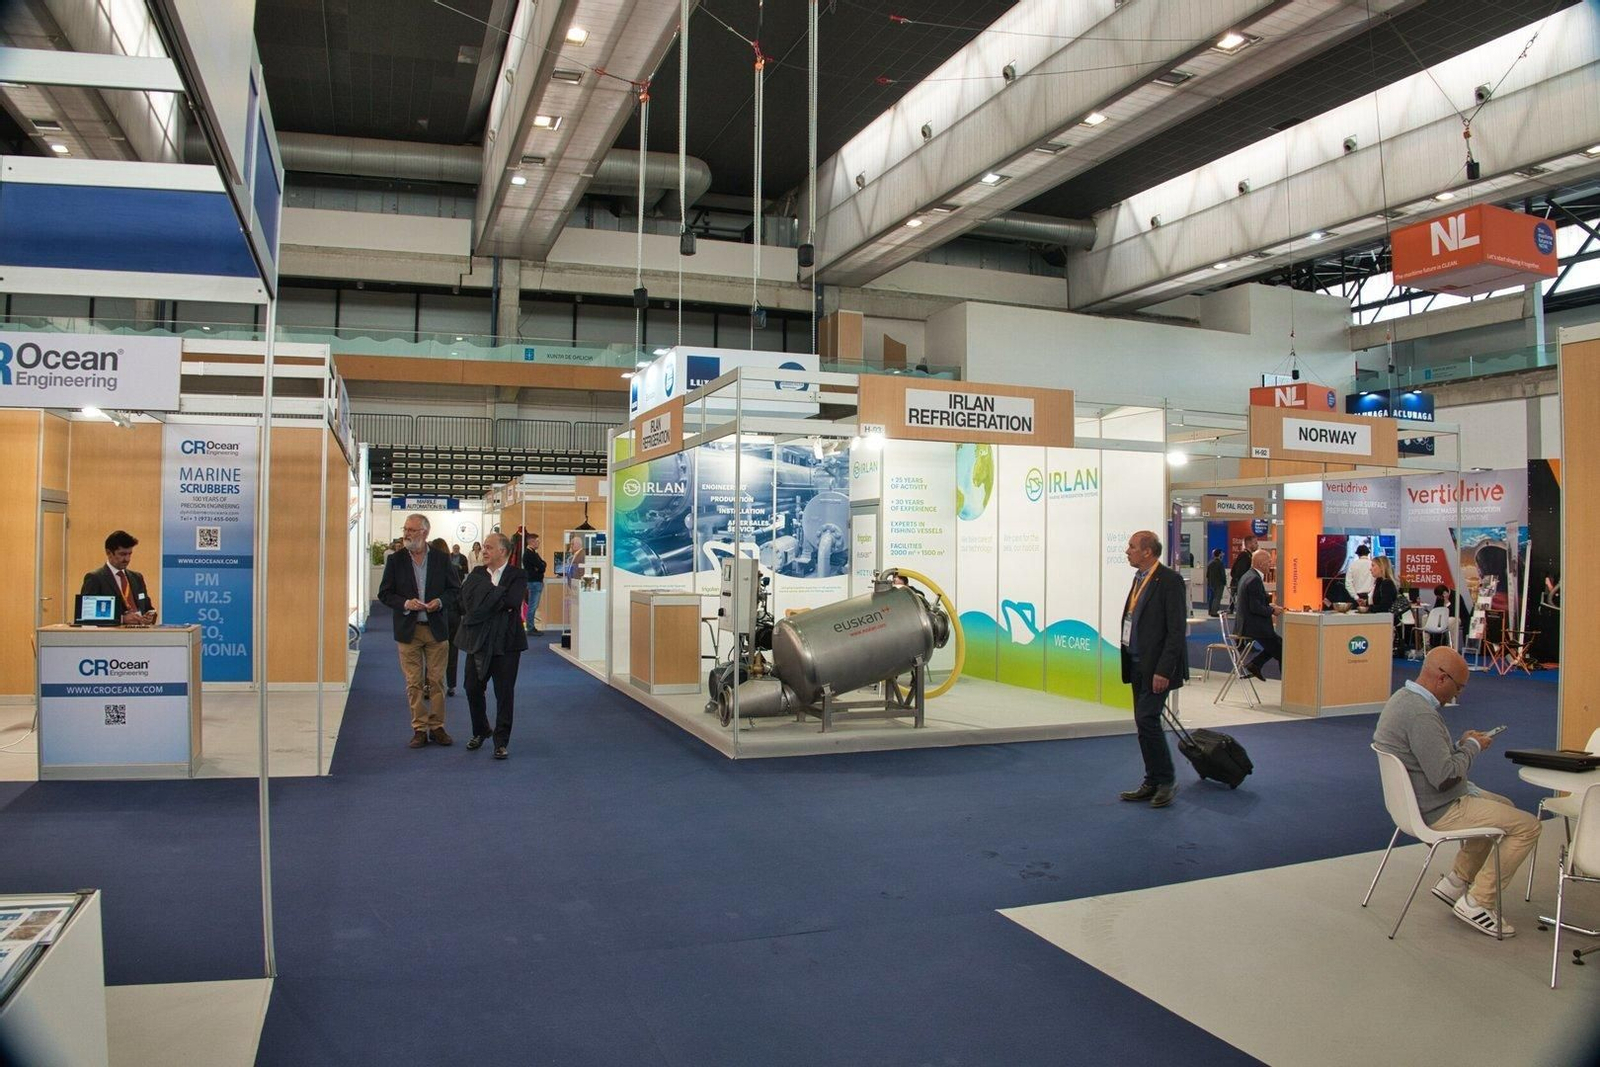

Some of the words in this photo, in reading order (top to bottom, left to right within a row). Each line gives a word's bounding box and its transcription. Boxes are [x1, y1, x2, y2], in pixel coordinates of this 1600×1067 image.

[1430, 213, 1480, 256] NL
[16, 371, 118, 391] Engineering
[949, 394, 994, 412] IRLAN
[1275, 387, 1304, 407] NL
[909, 408, 1032, 432] REFRIGERATION
[1299, 426, 1357, 445] NORWAY
[181, 440, 205, 454] CR
[180, 467, 241, 482] MARINE
[1049, 468, 1098, 493] IRLAN
[180, 484, 240, 495] SCRUBBERS
[643, 482, 685, 494] IRLAN
[1326, 482, 1368, 494] vertidrive
[1407, 479, 1504, 505] vertidrive
[1406, 554, 1438, 564] FASTER.
[1406, 564, 1434, 573] SAFER.
[195, 573, 219, 586] PM
[1406, 574, 1444, 583] CLEANER.
[184, 591, 232, 604] PM2.5
[1054, 634, 1067, 648] WE
[1068, 636, 1091, 651] CARE
[1351, 641, 1366, 651] TMC
[79, 659, 109, 676] CR
[66, 685, 164, 695] WWW.CROCEANX.COM
